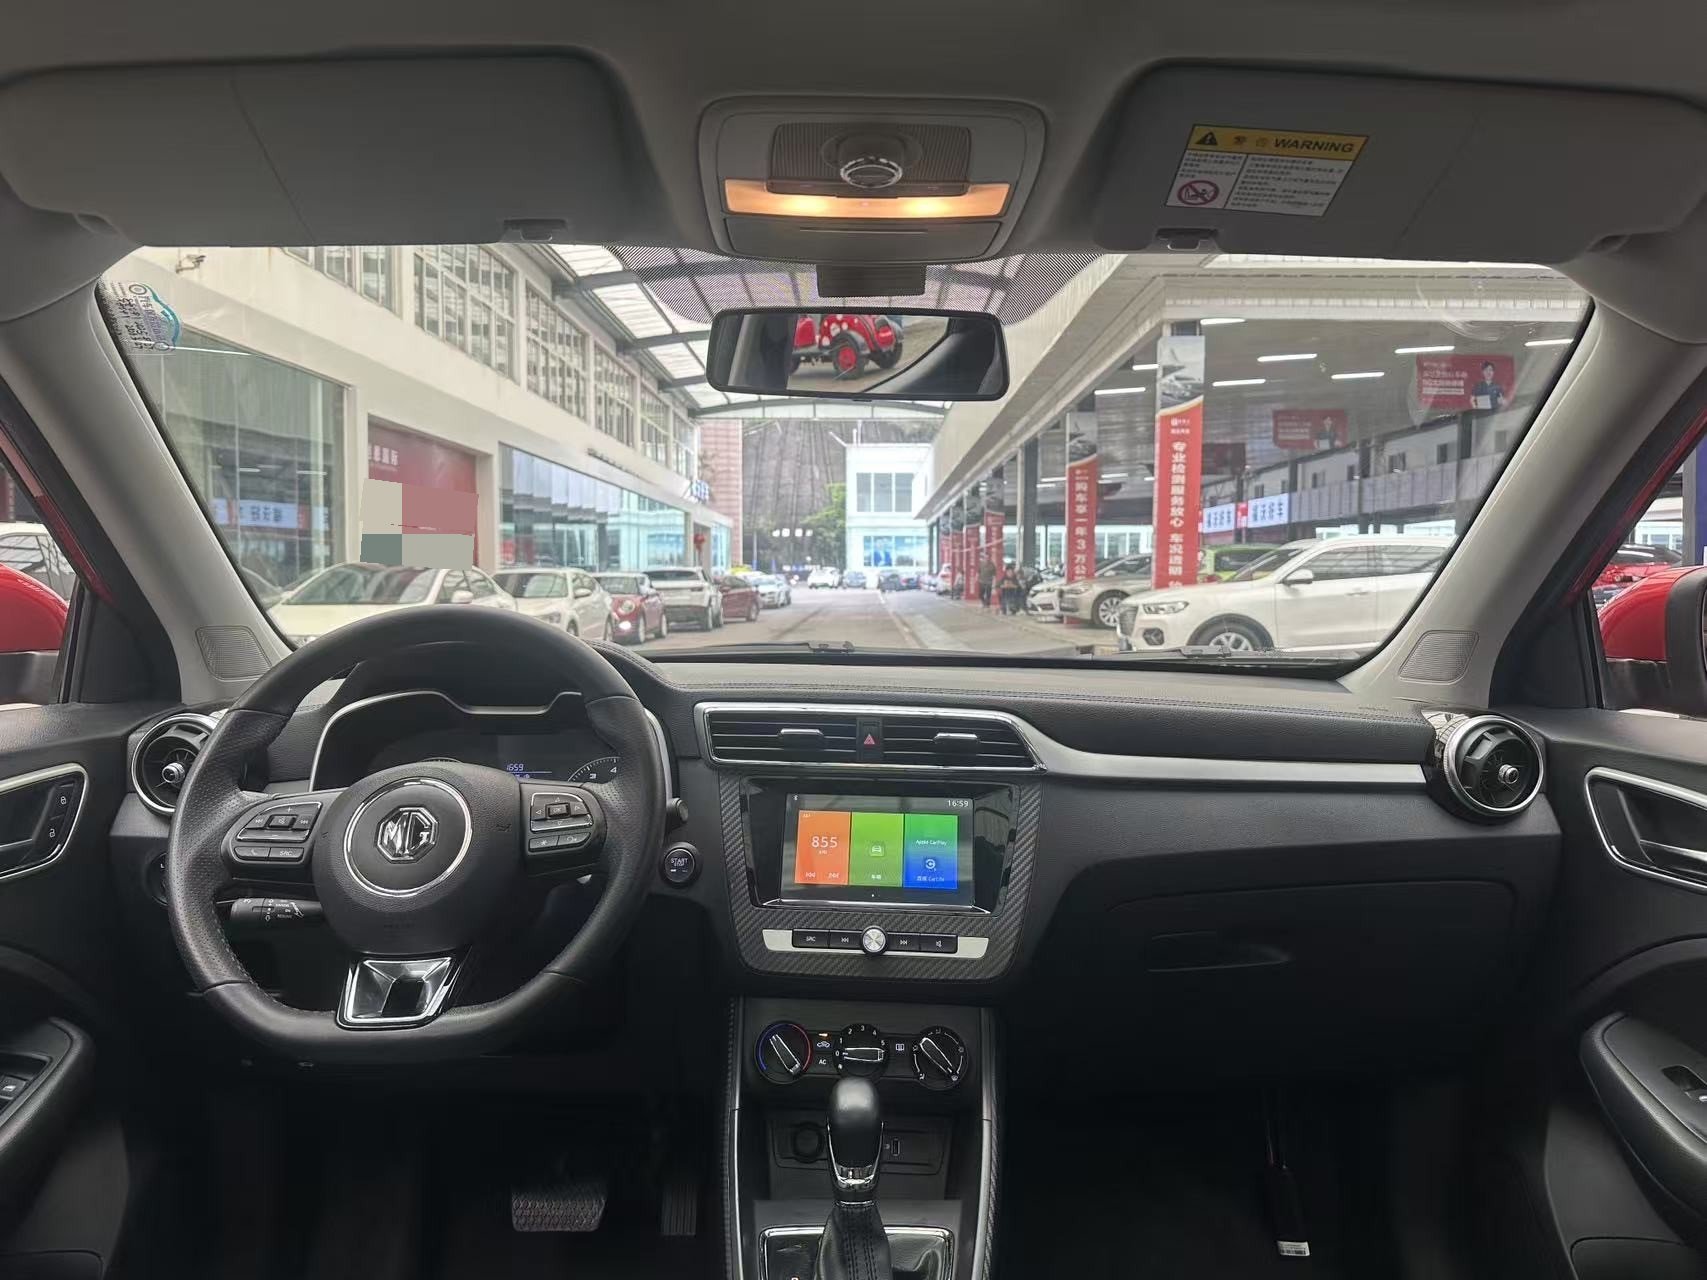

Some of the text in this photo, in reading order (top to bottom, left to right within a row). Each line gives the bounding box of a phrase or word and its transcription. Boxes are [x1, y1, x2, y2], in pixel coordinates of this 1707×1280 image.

[1274, 138, 1354, 153] WARNING
[948, 800, 969, 808] 16:59
[383, 812, 431, 856] MG
[811, 836, 838, 848] 855
